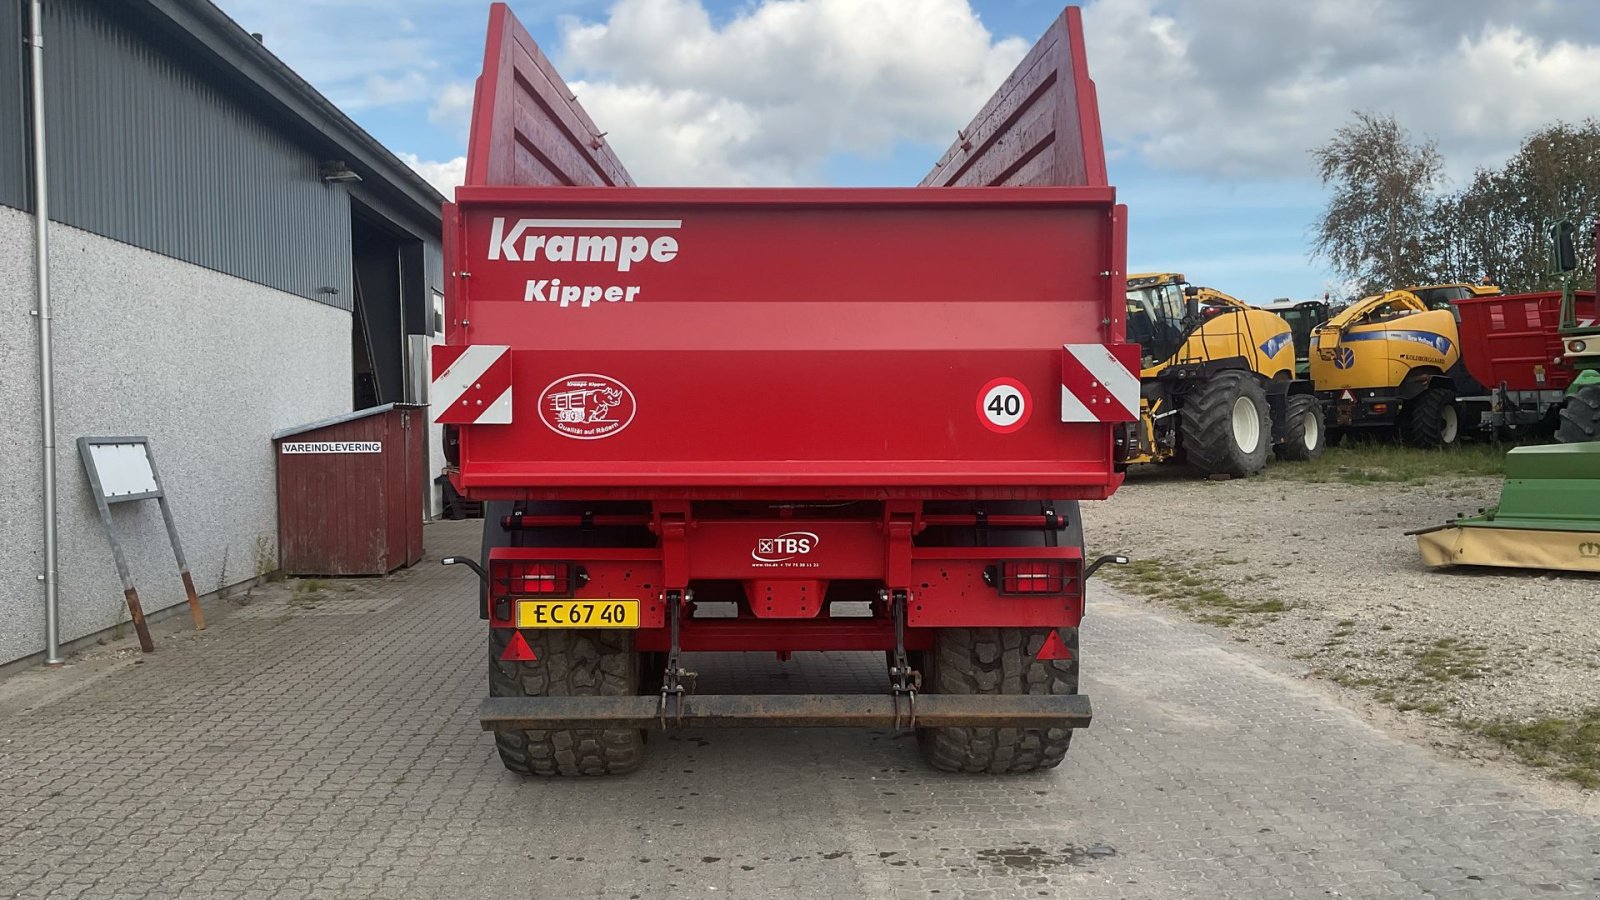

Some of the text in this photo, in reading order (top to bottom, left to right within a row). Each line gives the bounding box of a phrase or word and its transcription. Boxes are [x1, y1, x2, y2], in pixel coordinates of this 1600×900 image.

[488, 217, 682, 272] Krampe
[524, 278, 641, 308] Kipper
[987, 394, 1021, 416] 40
[557, 422, 583, 435] Qualität
[596, 422, 619, 434] Rädern
[283, 442, 381, 452] VAREINDLEVERING
[773, 538, 811, 554] TBS
[534, 604, 626, 624] EC 67 40
